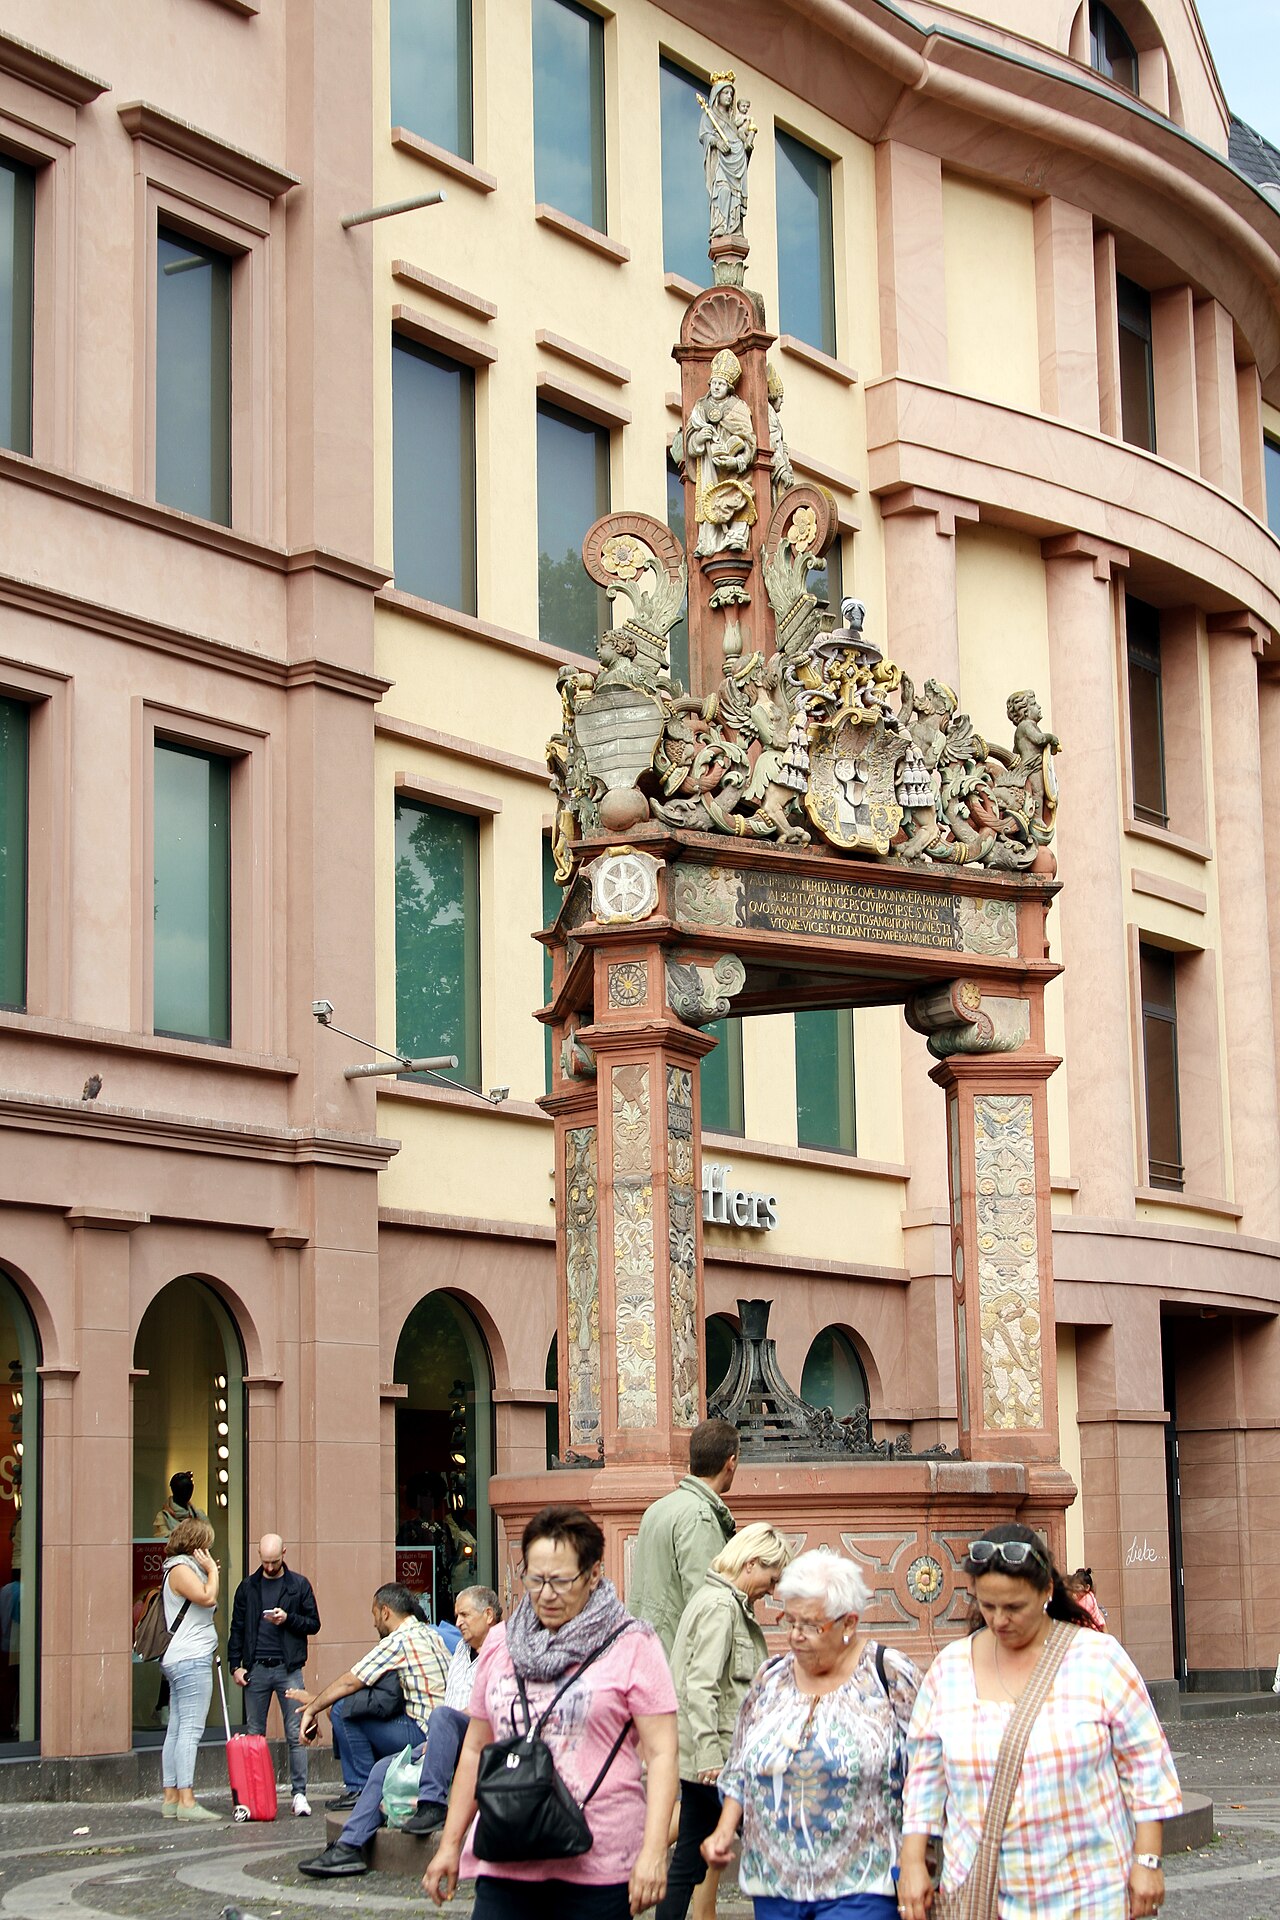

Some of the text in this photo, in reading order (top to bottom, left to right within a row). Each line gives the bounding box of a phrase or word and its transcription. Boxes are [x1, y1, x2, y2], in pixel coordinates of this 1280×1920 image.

[816, 895, 859, 911] PRINCEPS
[860, 900, 894, 915] CIVIBVS
[895, 904, 915, 918] IPSE
[916, 907, 939, 921] SVIS
[402, 1561, 423, 1577] SSV
